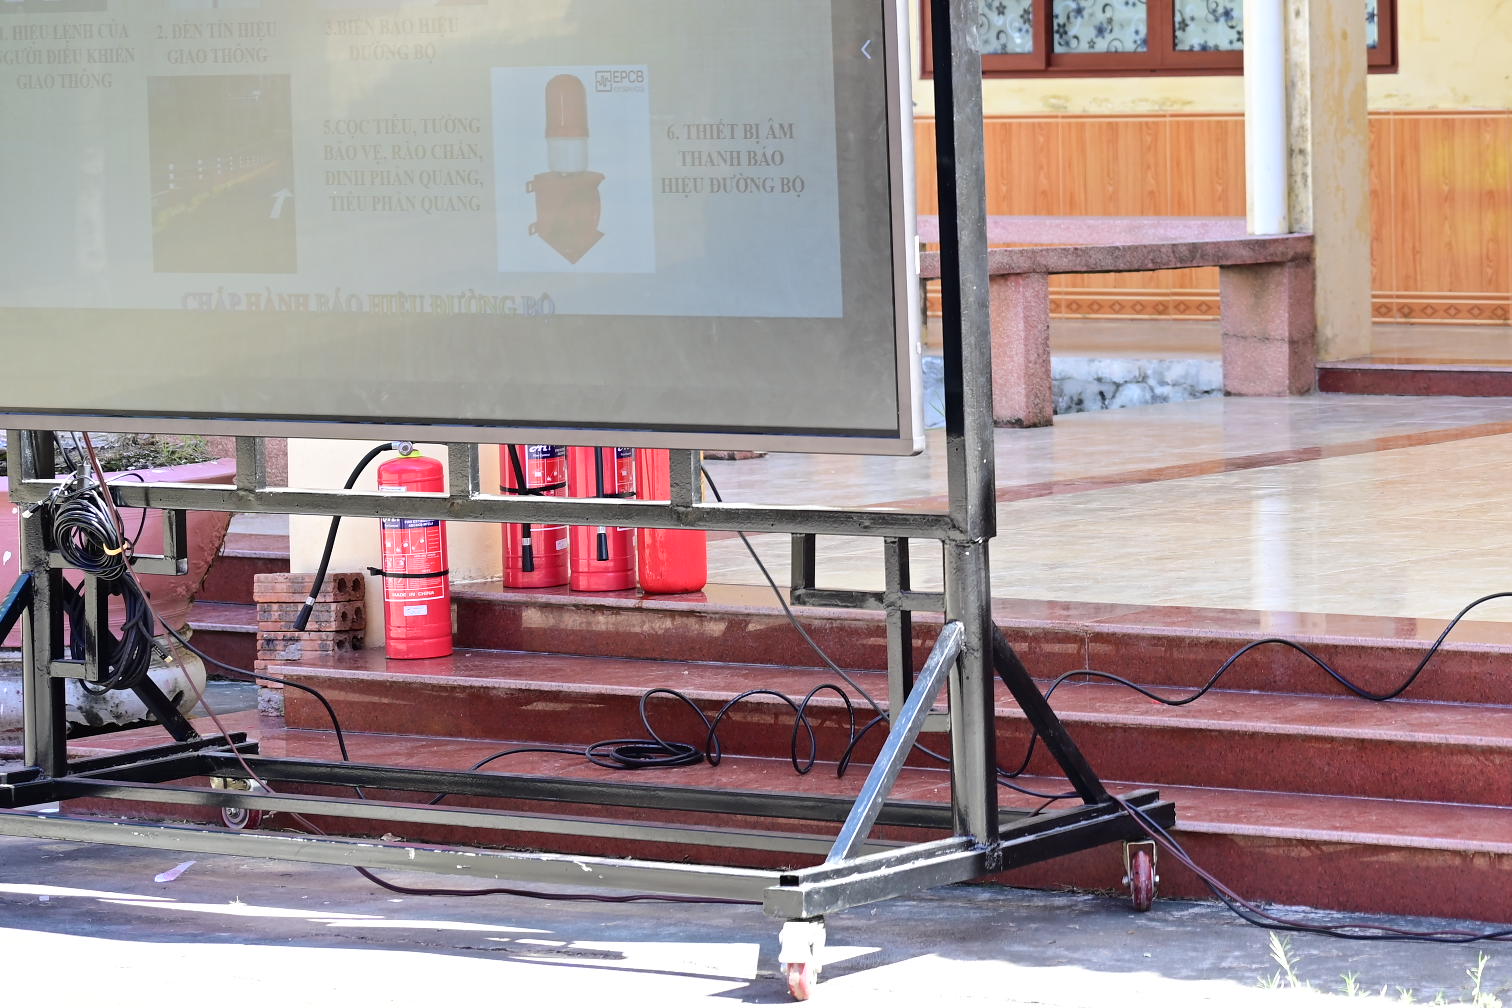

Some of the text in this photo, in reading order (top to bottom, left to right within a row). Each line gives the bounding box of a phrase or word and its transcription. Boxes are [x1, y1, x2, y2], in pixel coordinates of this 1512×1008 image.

[0, 46, 42, 65] GƯỜI
[16, 72, 55, 89] GIAO
[613, 70, 644, 83] EPCB
[679, 150, 742, 167] THANH
[421, 195, 480, 215] QUANG
